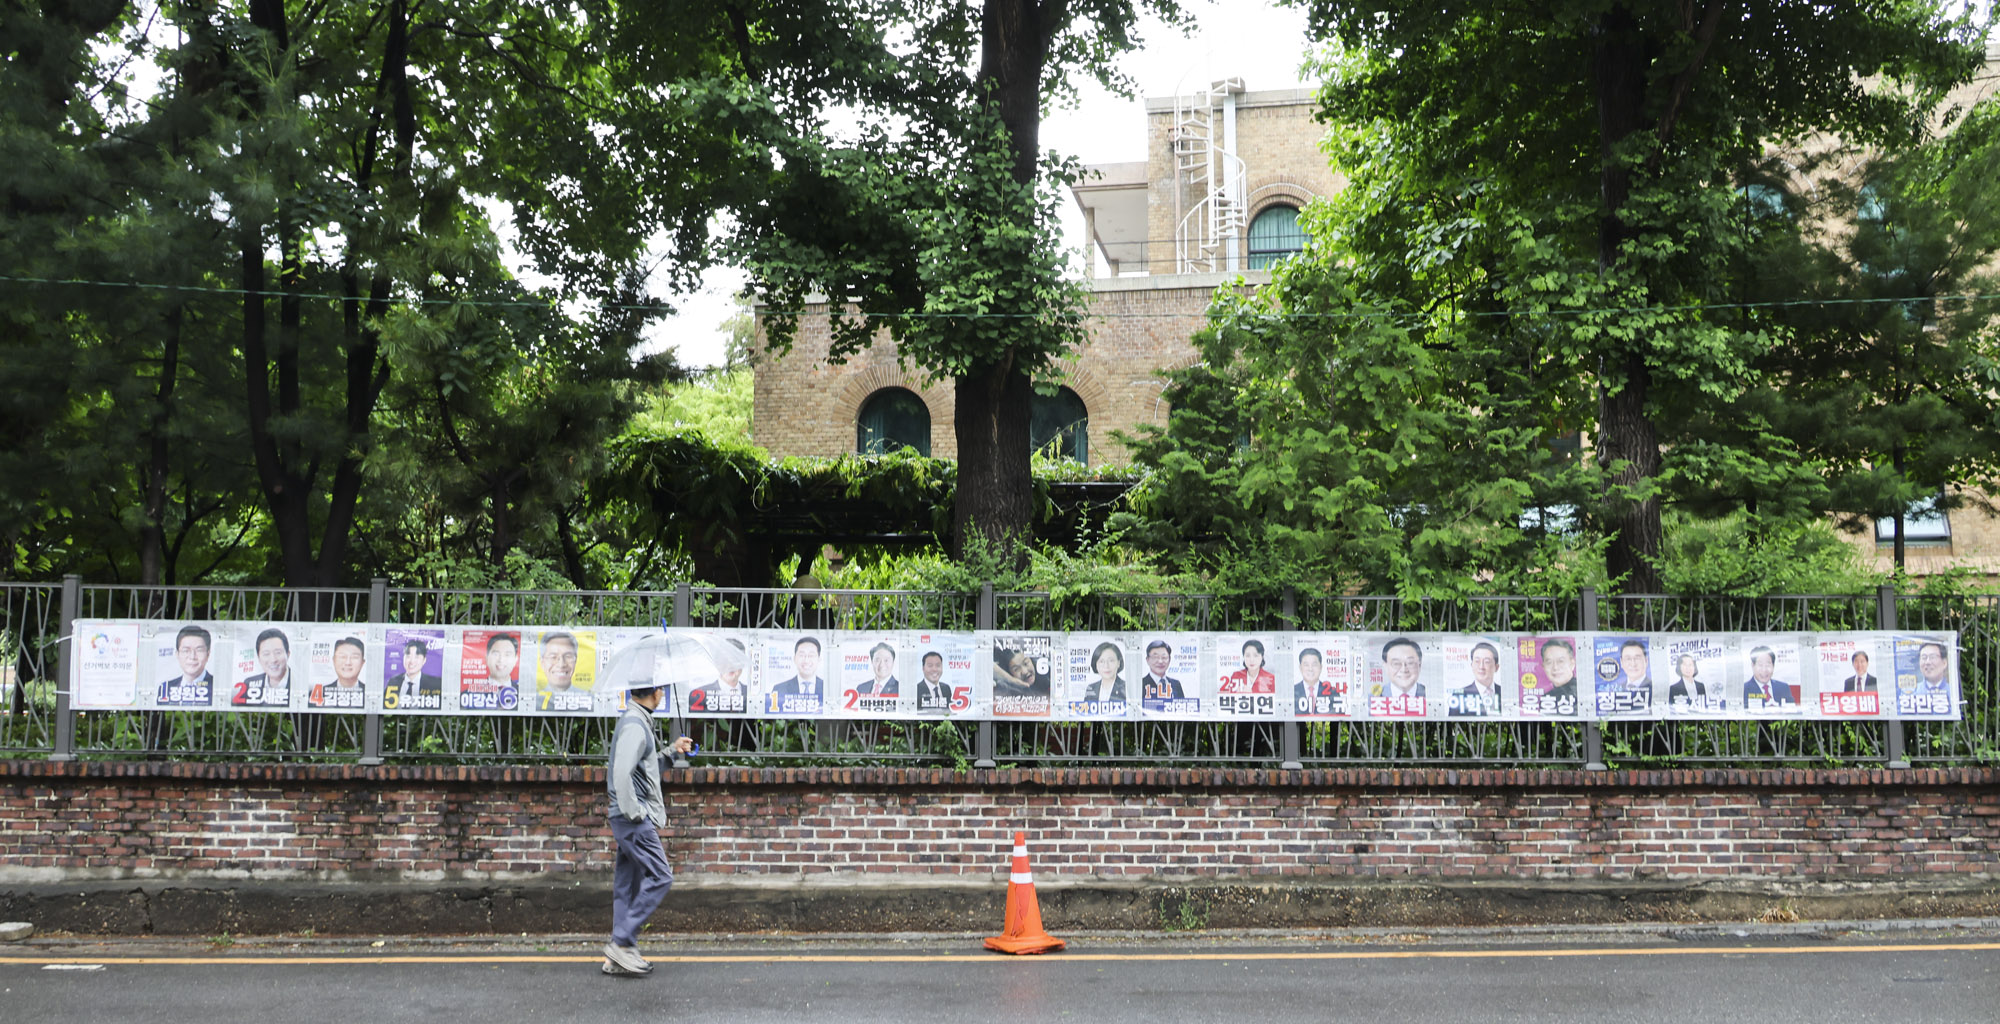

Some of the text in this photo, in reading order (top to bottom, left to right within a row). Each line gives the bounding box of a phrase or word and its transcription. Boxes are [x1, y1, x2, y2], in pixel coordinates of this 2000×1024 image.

[1669, 638, 1709, 653] 교실에서
[1695, 648, 1722, 661] 교육감
[1036, 657, 1050, 675] 6
[158, 681, 169, 702] 1
[169, 686, 209, 702] 정원오
[233, 682, 247, 704] 2
[246, 688, 289, 705] 오세훈
[310, 684, 324, 707] 4
[324, 691, 364, 707] 김정철
[384, 686, 399, 709] 5
[399, 694, 440, 709] 유지혜
[460, 693, 498, 708] 이강산
[499, 686, 519, 710] 6
[538, 691, 552, 710] 7
[617, 689, 628, 711] 1
[690, 689, 705, 711] 2
[769, 690, 780, 713] 1
[843, 689, 859, 712] 2
[950, 686, 972, 711] 5
[1598, 691, 1650, 711] 정근식
[706, 695, 743, 711] 정문헌
[859, 699, 897, 713] 박병철
[1090, 701, 1126, 716] 이미자
[1219, 695, 1274, 715] 박희연
[1298, 696, 1348, 713] 이광규
[1370, 696, 1425, 716] 조전혁
[1522, 695, 1575, 715] 윤호상
[1822, 695, 1877, 713] 김영배
[1900, 694, 1949, 714] 한만중
